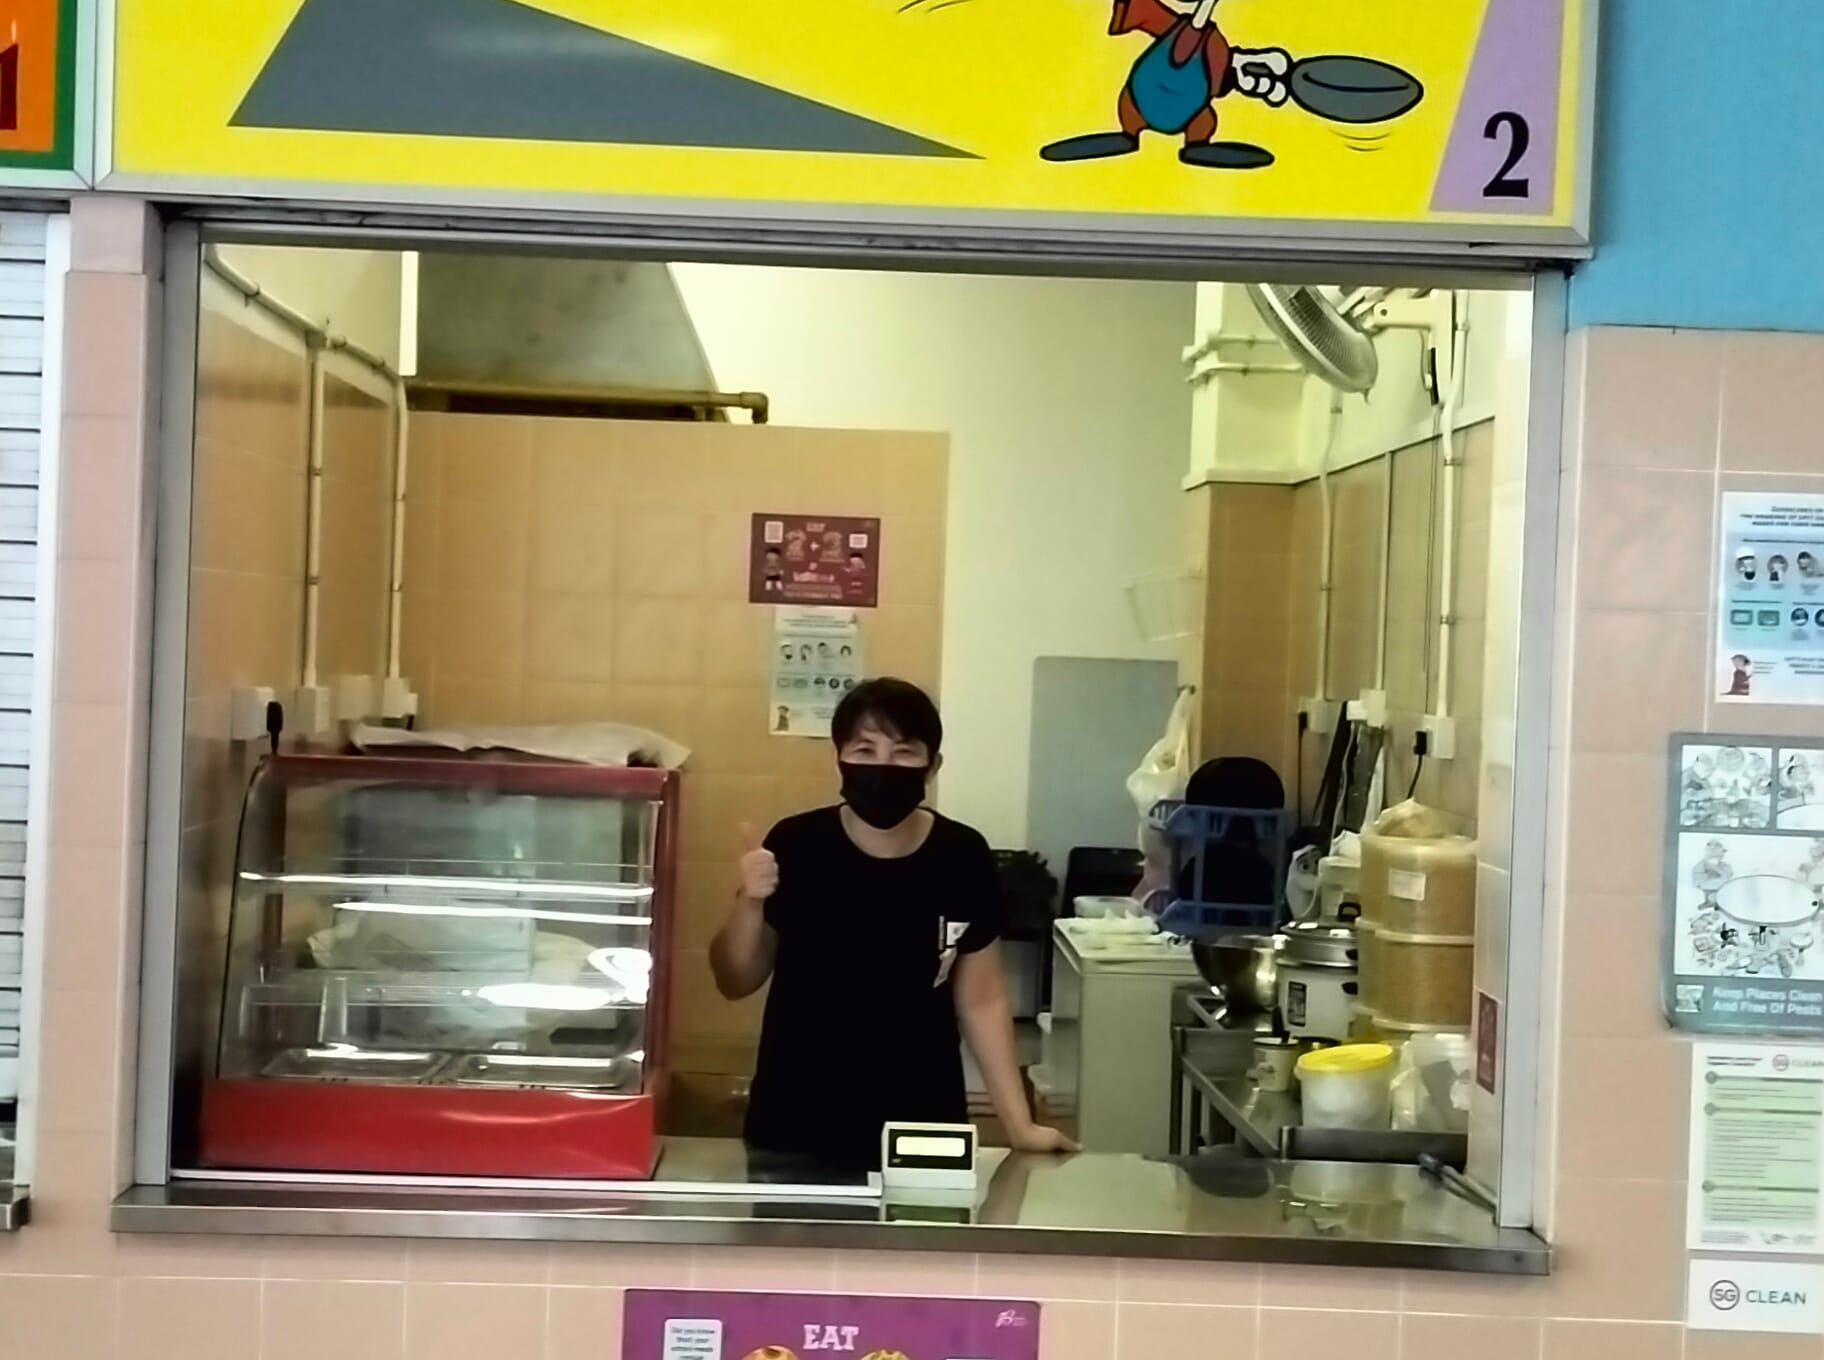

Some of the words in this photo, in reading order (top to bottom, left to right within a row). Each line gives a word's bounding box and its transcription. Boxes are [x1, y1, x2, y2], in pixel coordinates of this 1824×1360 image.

[1483, 111, 1529, 198] 2
[1788, 989, 1823, 1002] Clean
[1770, 1002, 1785, 1014] Of
[1746, 1289, 1806, 1305] CLEAN
[803, 1324, 859, 1350] EAT
